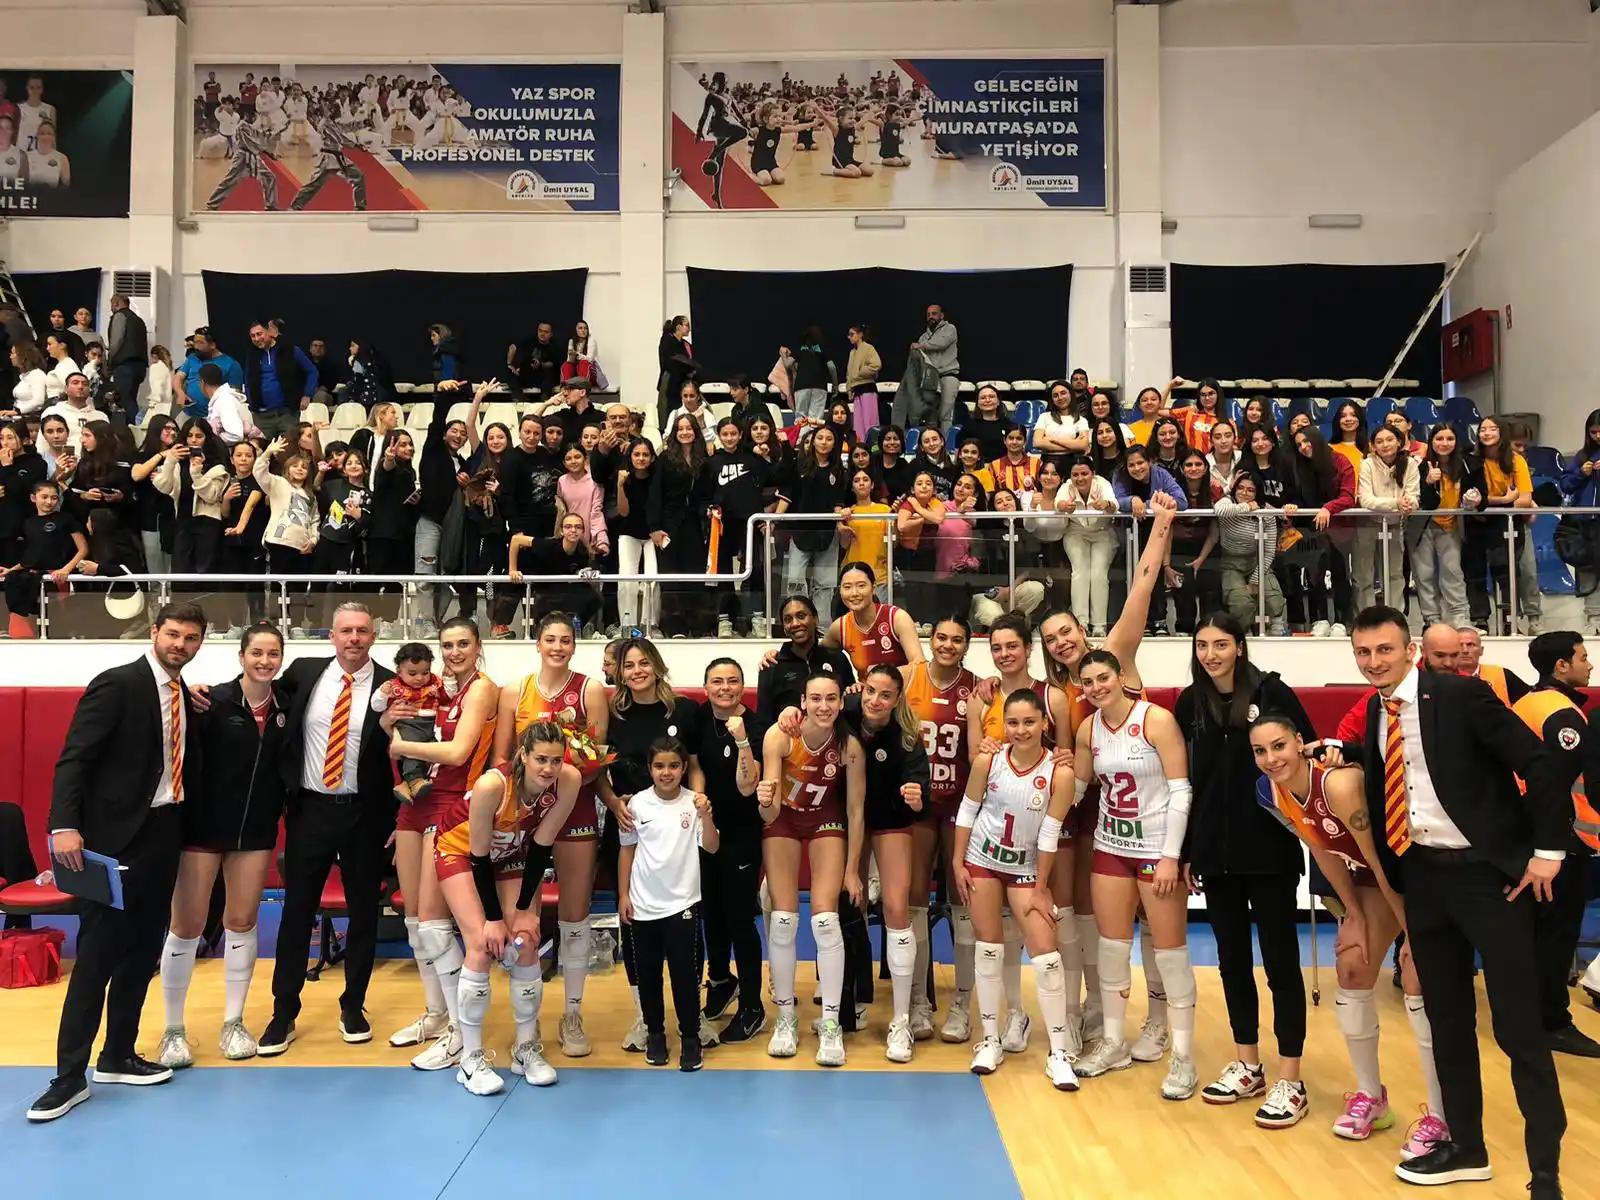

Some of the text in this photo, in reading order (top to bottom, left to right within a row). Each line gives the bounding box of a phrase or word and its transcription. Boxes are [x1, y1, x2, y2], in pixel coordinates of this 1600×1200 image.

[974, 76, 1079, 92] GELECEĞİN
[511, 87, 596, 100] YAZ SPOR
[474, 108, 596, 121] OKULUMUZLA
[916, 97, 1079, 116] CİMNASTİKÇİLERİ
[467, 125, 596, 141] AMATÖR RUHA
[931, 121, 1079, 137] MURATPAŞA'DA
[401, 149, 596, 162] PROFESYONEL DESTEK
[980, 140, 1079, 159] YETİŞİYOR
[1047, 178, 1073, 186] UYSAL
[920, 720, 960, 758] 33
[929, 763, 956, 781] DI
[1099, 771, 1139, 818] 12
[1000, 812, 1015, 848] 1
[1103, 814, 1143, 840] HDI
[1102, 834, 1145, 849] SIGORTA
[982, 838, 1026, 865] HDI
